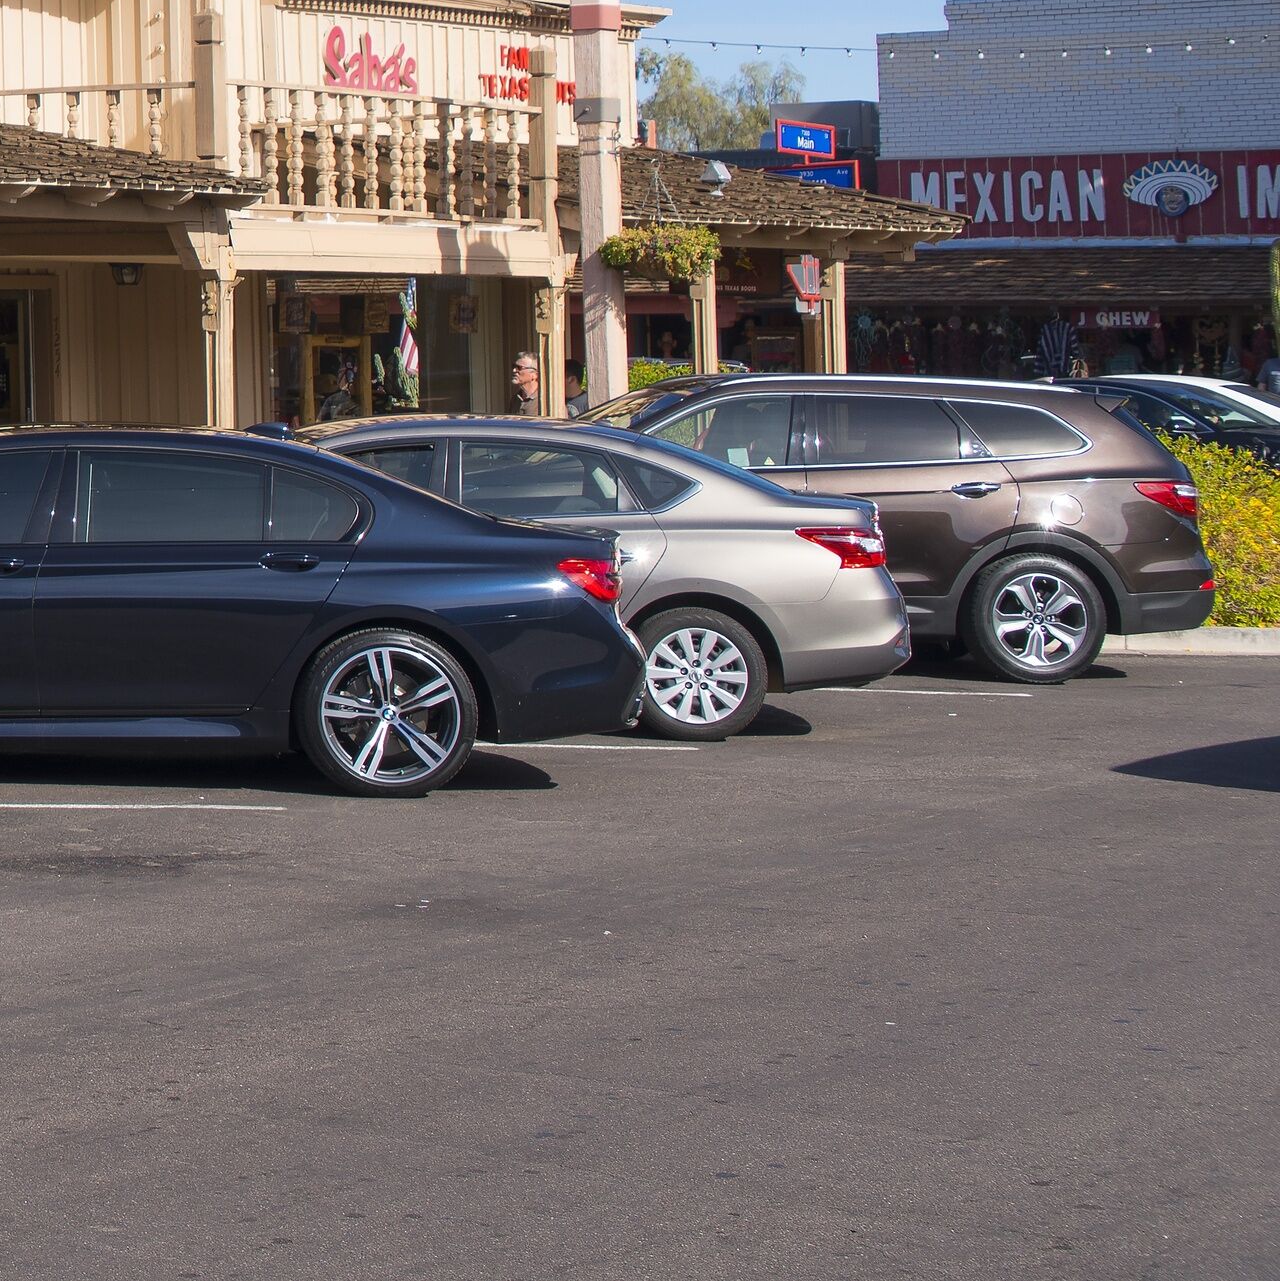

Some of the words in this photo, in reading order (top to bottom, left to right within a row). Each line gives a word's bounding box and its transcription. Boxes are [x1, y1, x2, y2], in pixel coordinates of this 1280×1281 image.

[479, 73, 530, 102] TEXAS
[797, 135, 815, 150] Main
[836, 168, 849, 176] Ave
[910, 168, 1106, 223] MEXICAN
[1237, 164, 1280, 219] IM
